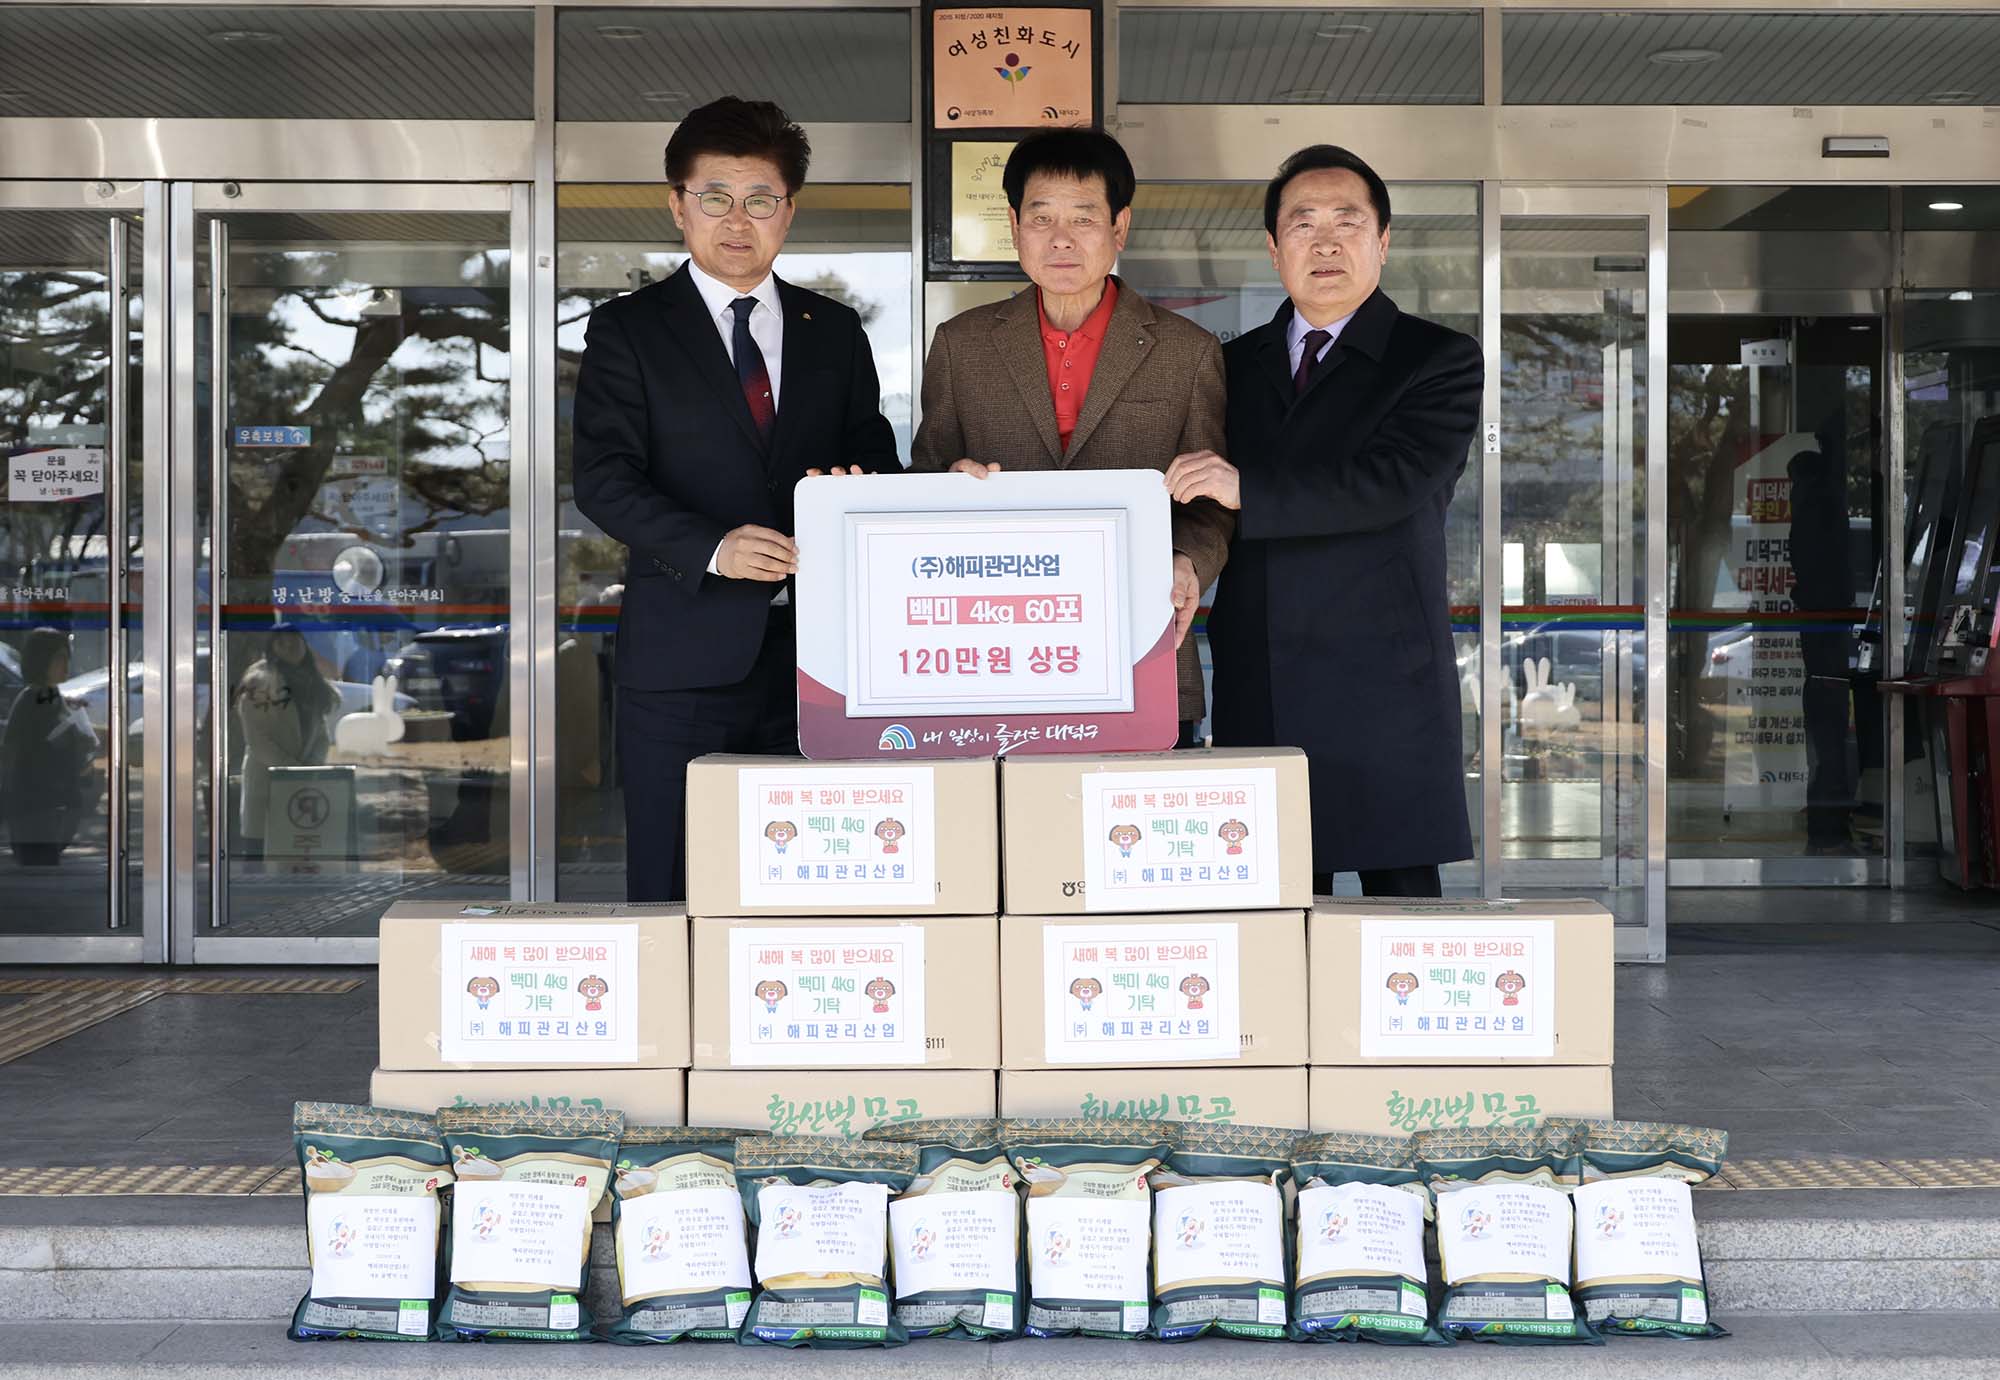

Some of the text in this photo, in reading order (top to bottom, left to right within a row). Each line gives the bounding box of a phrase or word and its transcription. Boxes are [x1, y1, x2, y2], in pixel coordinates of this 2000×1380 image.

[948, 26, 1080, 59] 여성친화도시
[14, 469, 98, 483] 꼭 닫아주세요!
[911, 554, 1060, 580] (주)해피관리산업
[909, 596, 1080, 625] 백미 4kg 60포
[899, 645, 1081, 676] 120만원 상당
[922, 722, 1098, 756] 내 일상이 즐거운 대덕구
[767, 788, 904, 806] 새해 복 많이 받으세요
[1111, 790, 1247, 808] 새해 복 많이 받으세요
[807, 815, 865, 834] 백미 4kg
[1151, 818, 1209, 836] 백미 4kg
[823, 837, 851, 855] 기탁
[1167, 839, 1195, 857] 기탁
[470, 946, 608, 962] 새해 복 많이 받으세요
[757, 948, 895, 965] 새해 복 많이 받으세요
[1072, 944, 1208, 963] 새해 복 많이 받으세요
[1390, 942, 1525, 958] 새해 복 많이 받으세요
[510, 972, 569, 991] 백미 4kg
[798, 975, 856, 993] 백미 4kg
[1112, 972, 1170, 990] 백미 4kg
[1429, 967, 1486, 986] 백미 4kg
[525, 994, 553, 1012] 기탁
[813, 997, 841, 1015] 기탁
[1127, 993, 1156, 1012] 기탁
[1443, 989, 1472, 1007] 기탁
[1386, 1090, 1474, 1132] 황산벌
[1306, 1320, 1322, 1328] NH
